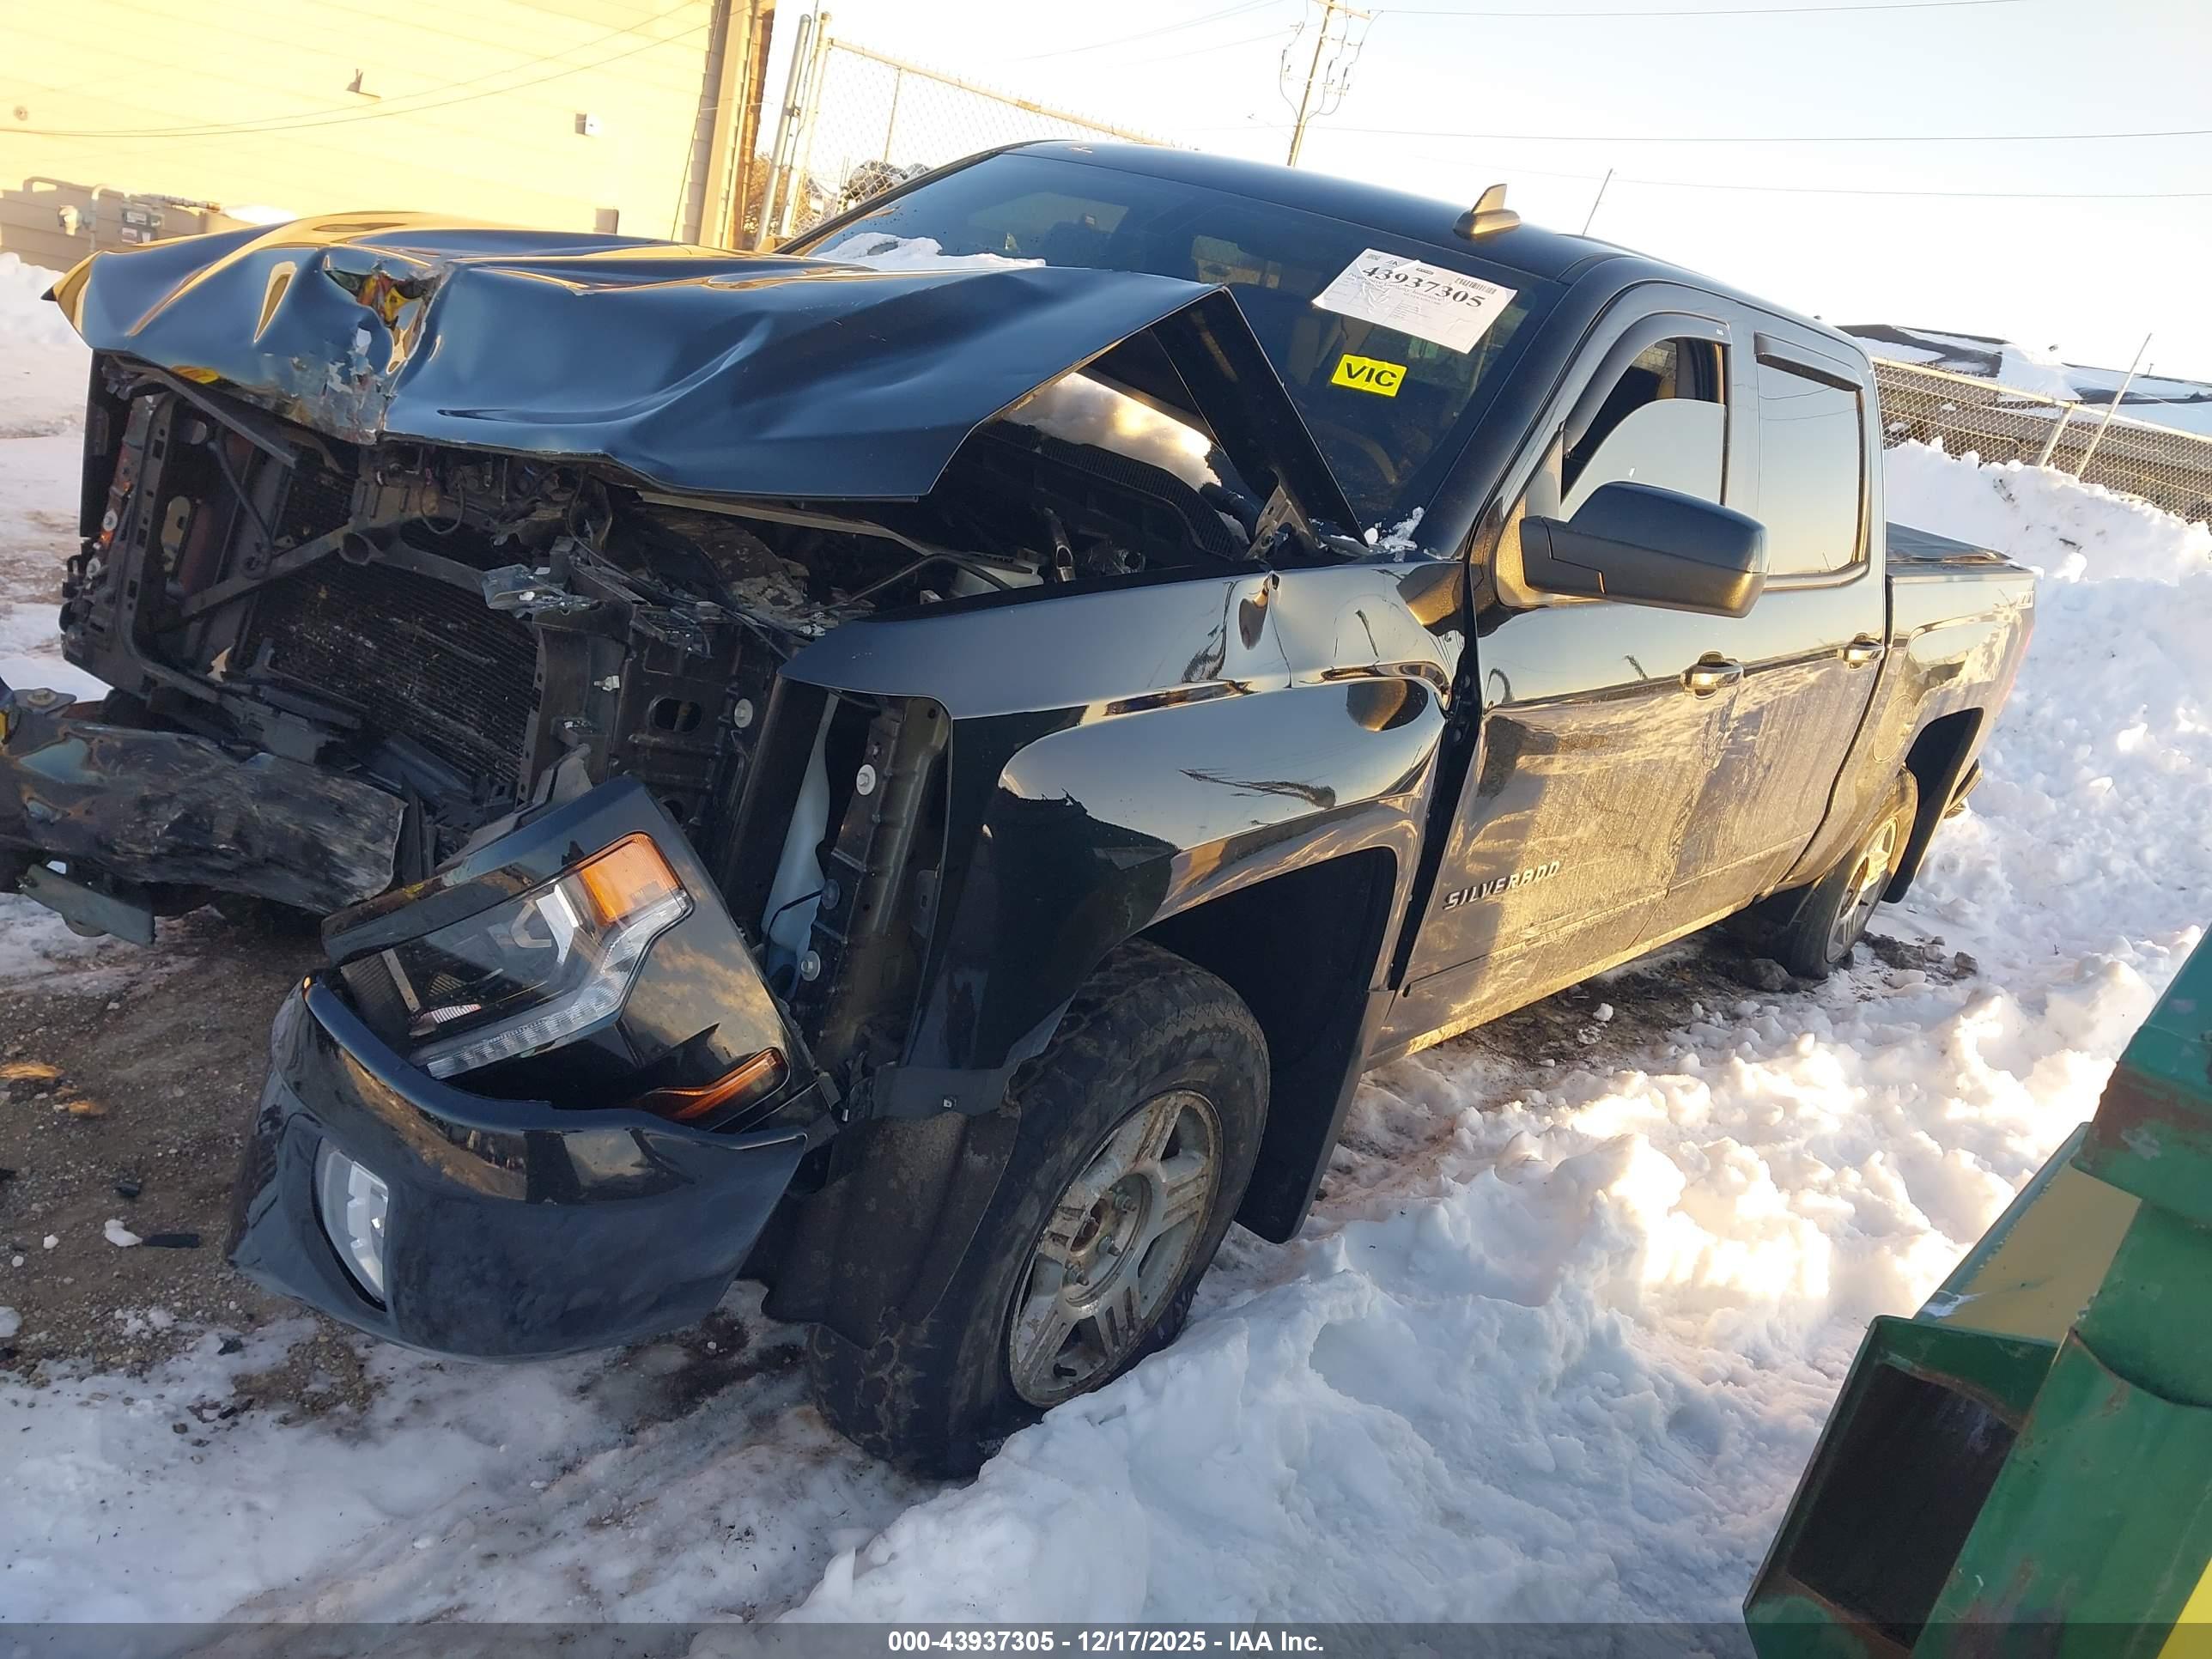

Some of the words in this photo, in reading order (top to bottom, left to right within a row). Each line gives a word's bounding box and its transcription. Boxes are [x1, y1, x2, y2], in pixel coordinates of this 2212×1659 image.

[1362, 267, 1486, 307] 43937305
[1346, 362, 1397, 386] VIC
[1443, 860, 1560, 910] SILVERADO
